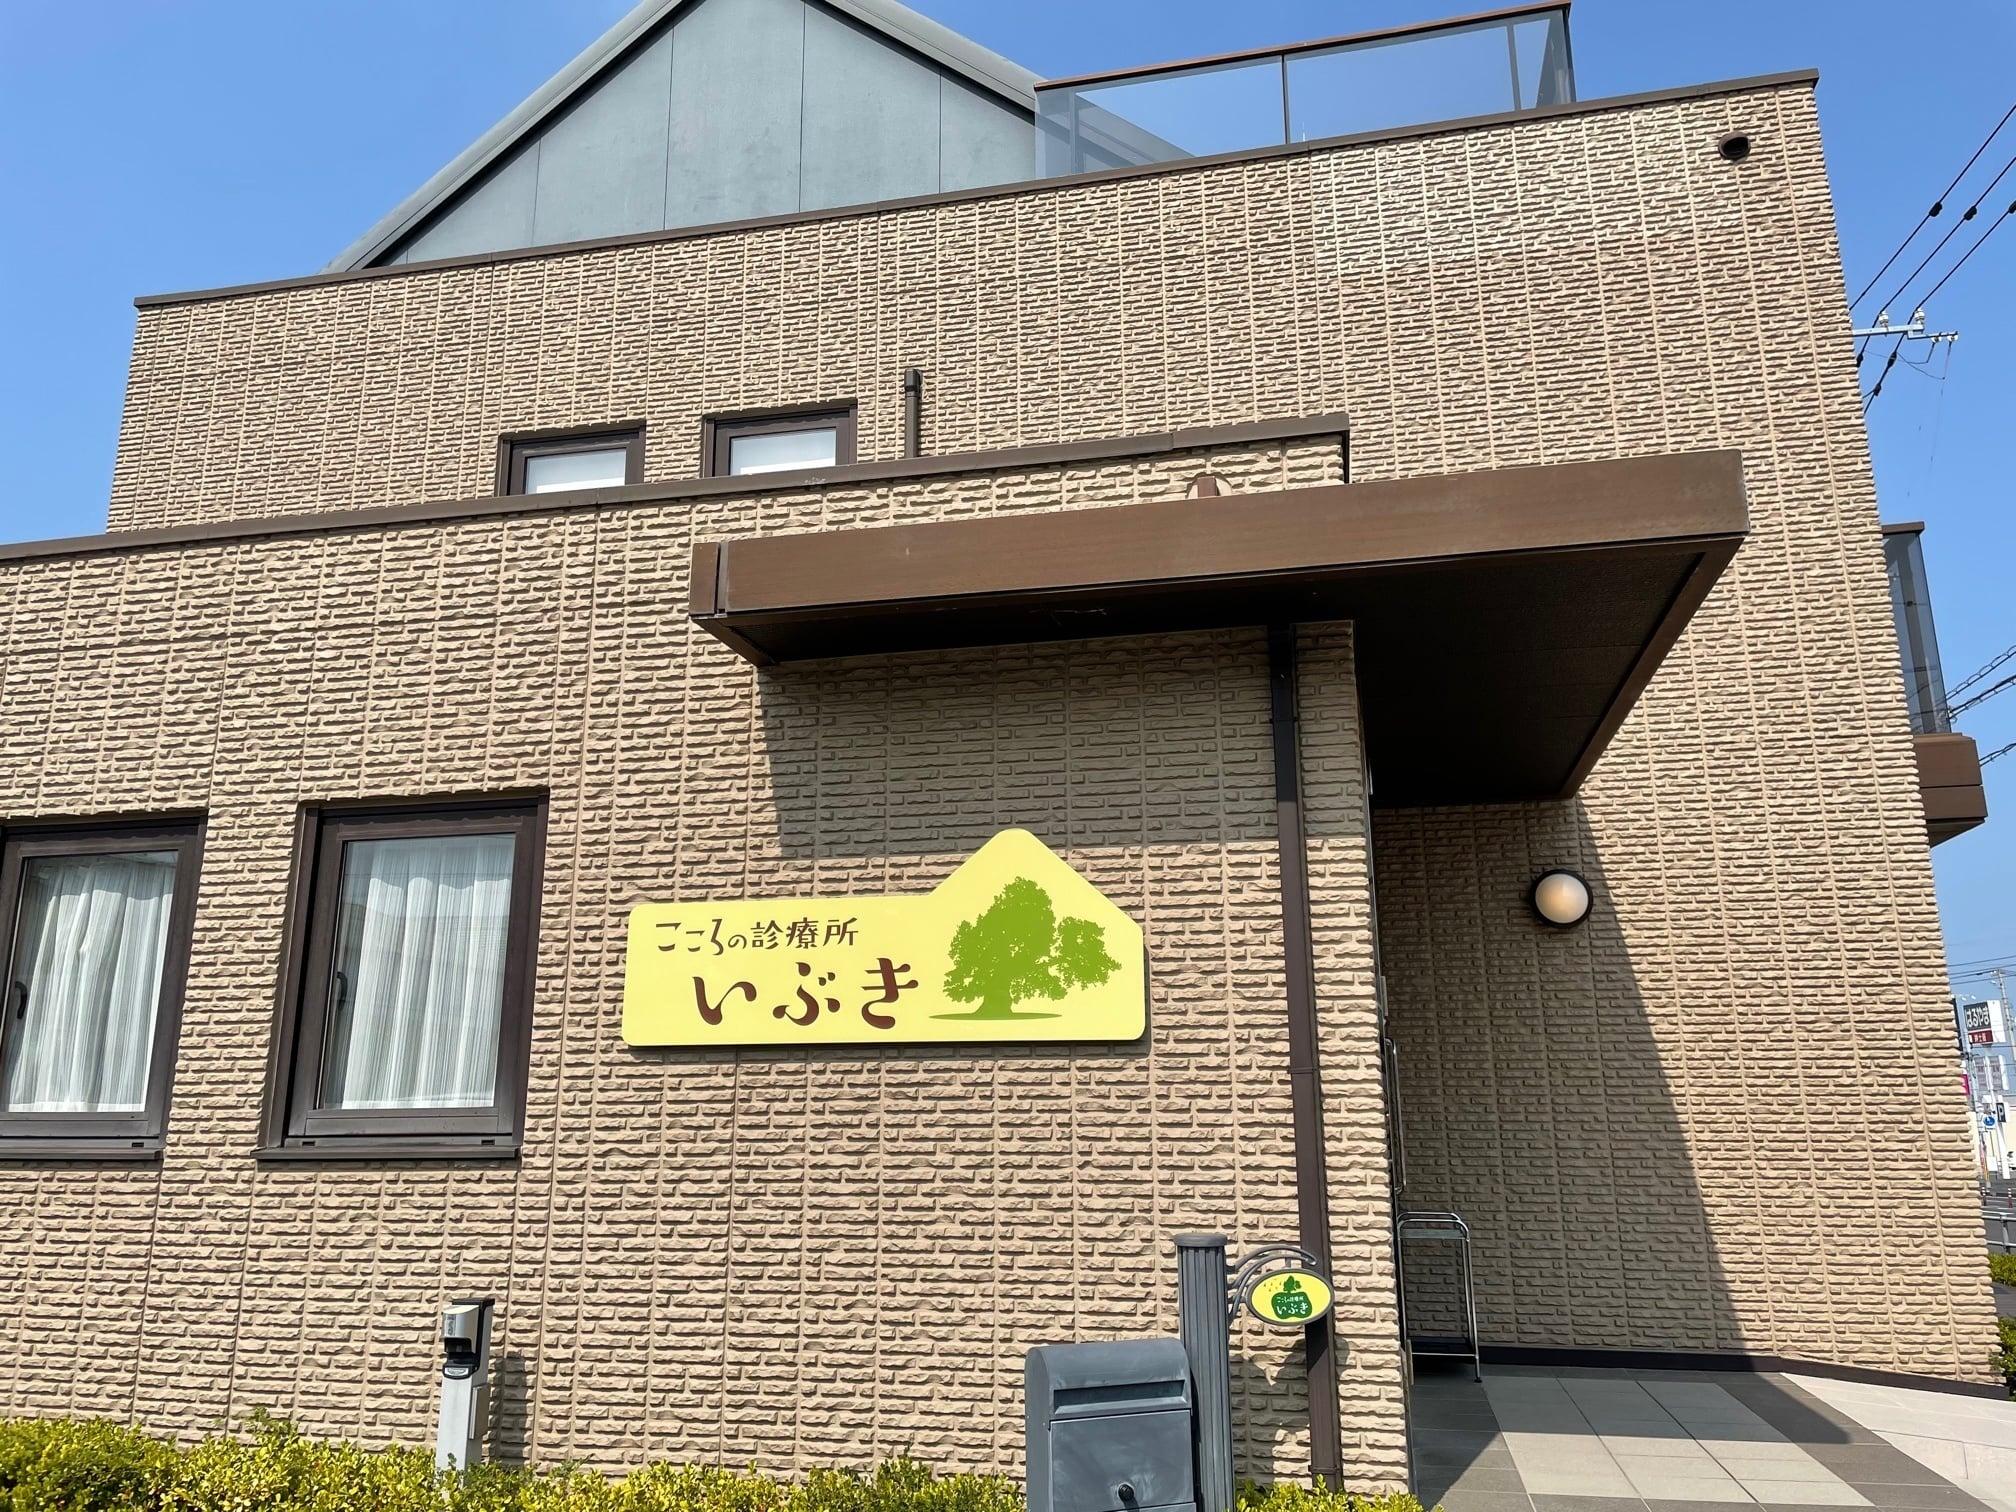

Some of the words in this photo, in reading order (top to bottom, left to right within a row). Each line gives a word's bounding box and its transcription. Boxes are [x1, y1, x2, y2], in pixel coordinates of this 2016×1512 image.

[655, 916, 859, 956] こころの診療所
[692, 957, 919, 1030] いぶき
[1965, 1005, 1989, 1028] はるやま
[1997, 1104, 2004, 1121] P
[1276, 1303, 1308, 1314] いぶき
